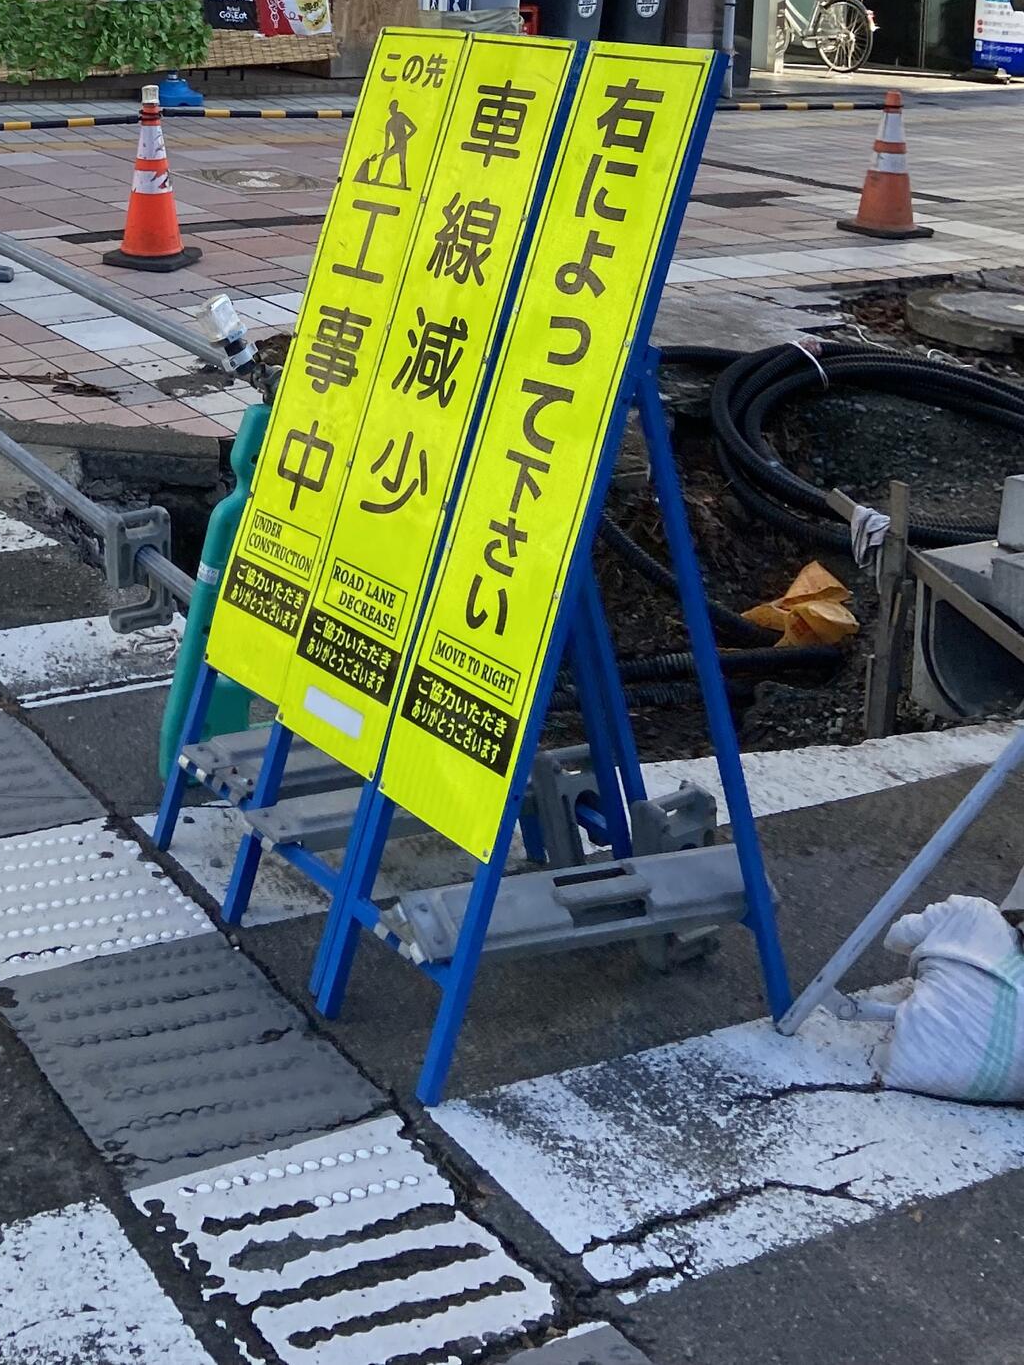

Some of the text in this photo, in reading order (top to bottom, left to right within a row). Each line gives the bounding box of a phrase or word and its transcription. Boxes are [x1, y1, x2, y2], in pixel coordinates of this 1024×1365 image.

[380, 52, 449, 89] この先
[359, 80, 536, 515] 車線減少
[277, 199, 400, 512] 工事中
[465, 79, 665, 636] 右によって下さい
[249, 532, 313, 574] CONSTRUCTION
[254, 514, 283, 540] UNDER
[230, 582, 298, 631] ありがとうございます
[237, 563, 305, 610] ご協力いただき
[333, 565, 397, 609] ROAD LANE
[338, 590, 397, 633] DECREASE
[306, 636, 386, 694] ありがとうございます
[313, 615, 392, 671] ご協力いただき
[435, 639, 516, 695] MOVE TO RIGHT
[411, 697, 501, 764] ありがとうございます
[418, 675, 508, 739] ご協力いただき
